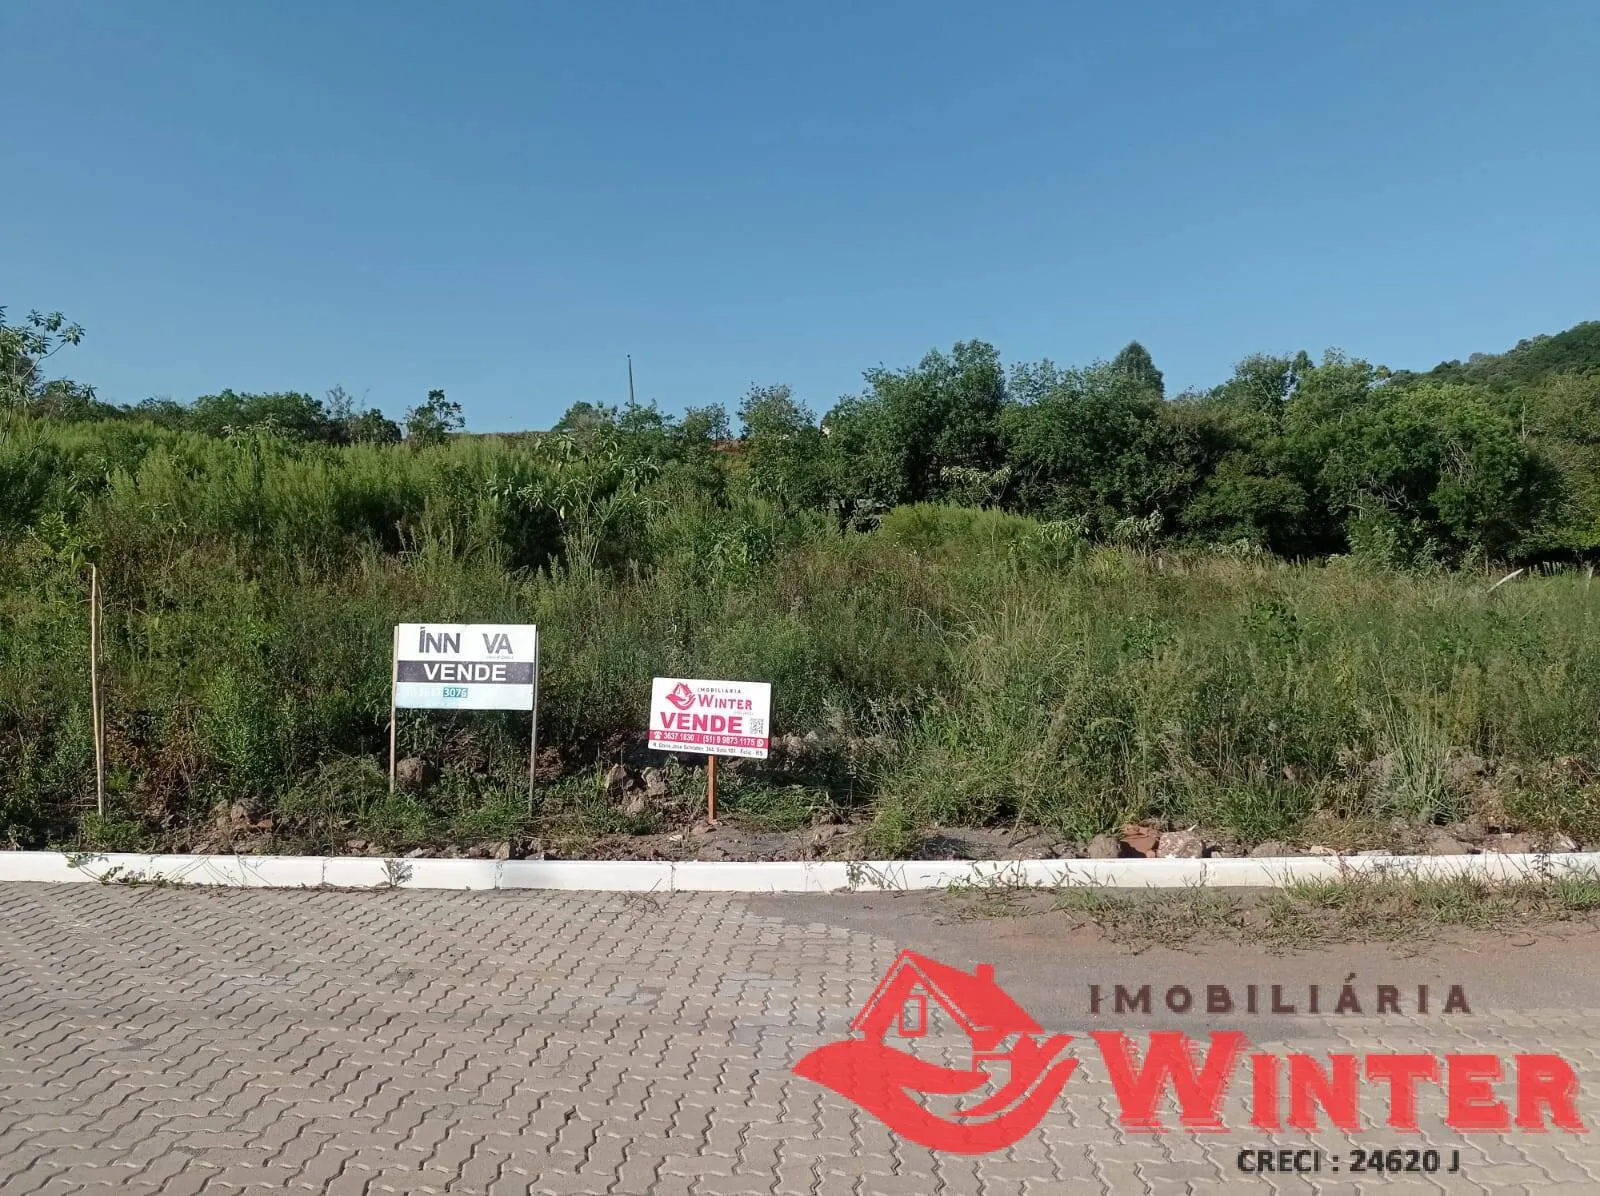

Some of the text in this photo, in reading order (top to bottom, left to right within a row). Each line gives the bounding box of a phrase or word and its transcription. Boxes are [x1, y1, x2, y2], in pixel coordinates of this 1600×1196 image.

[423, 663, 507, 682] VENDE
[697, 694, 753, 711] WINTER
[660, 711, 743, 734] VENDE
